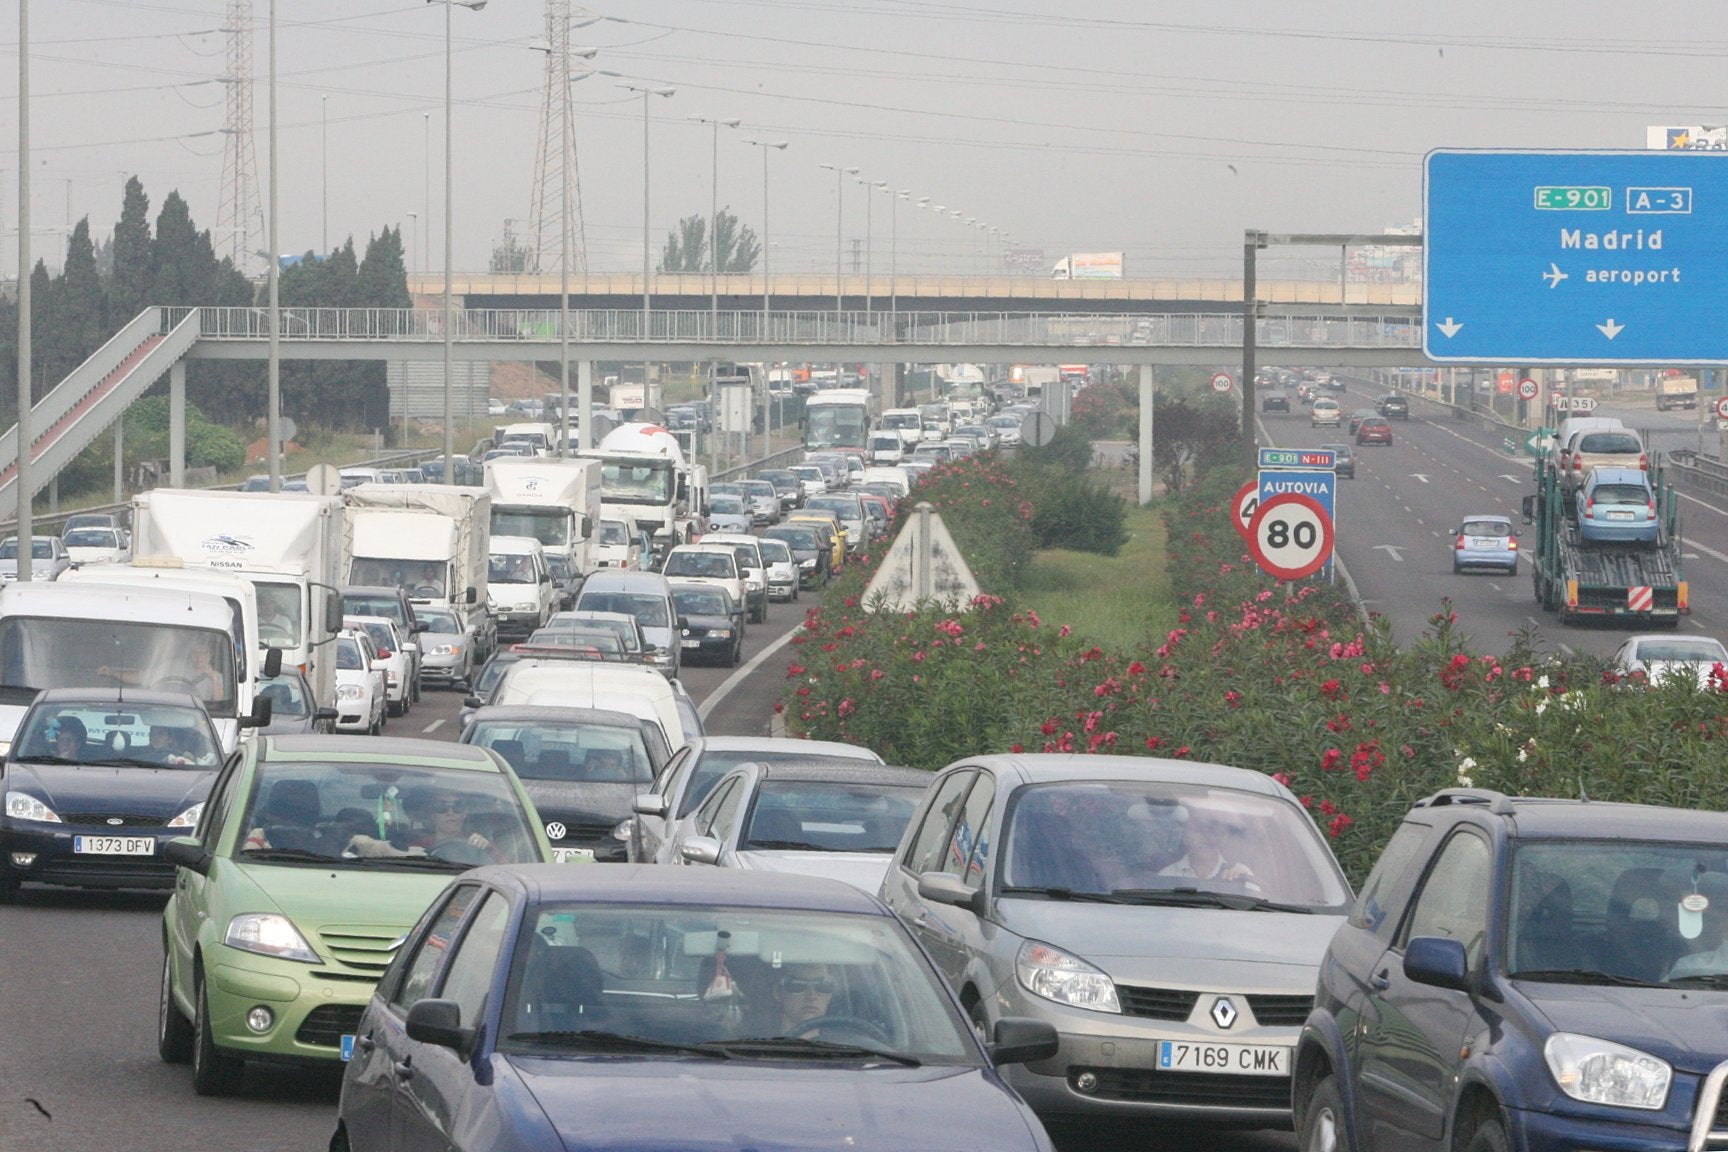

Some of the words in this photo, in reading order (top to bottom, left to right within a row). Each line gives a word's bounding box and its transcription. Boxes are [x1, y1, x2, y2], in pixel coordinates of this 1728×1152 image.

[1538, 189, 1608, 208] E-901
[1635, 192, 1684, 210] A-3
[1560, 228, 1663, 250] Madrid
[1585, 267, 1681, 286] aeroport
[1215, 379, 1229, 388] 100
[1521, 385, 1536, 394] 100
[1573, 399, 1594, 409] 351
[1265, 453, 1297, 463] E-901
[1263, 481, 1329, 494] AUTOVIA
[1241, 497, 1258, 518] 4
[1266, 519, 1317, 549] 80
[88, 838, 122, 852] 1373
[126, 839, 152, 853] DFV
[1176, 1045, 1230, 1067] 7169
[1239, 1049, 1280, 1070] CMK
